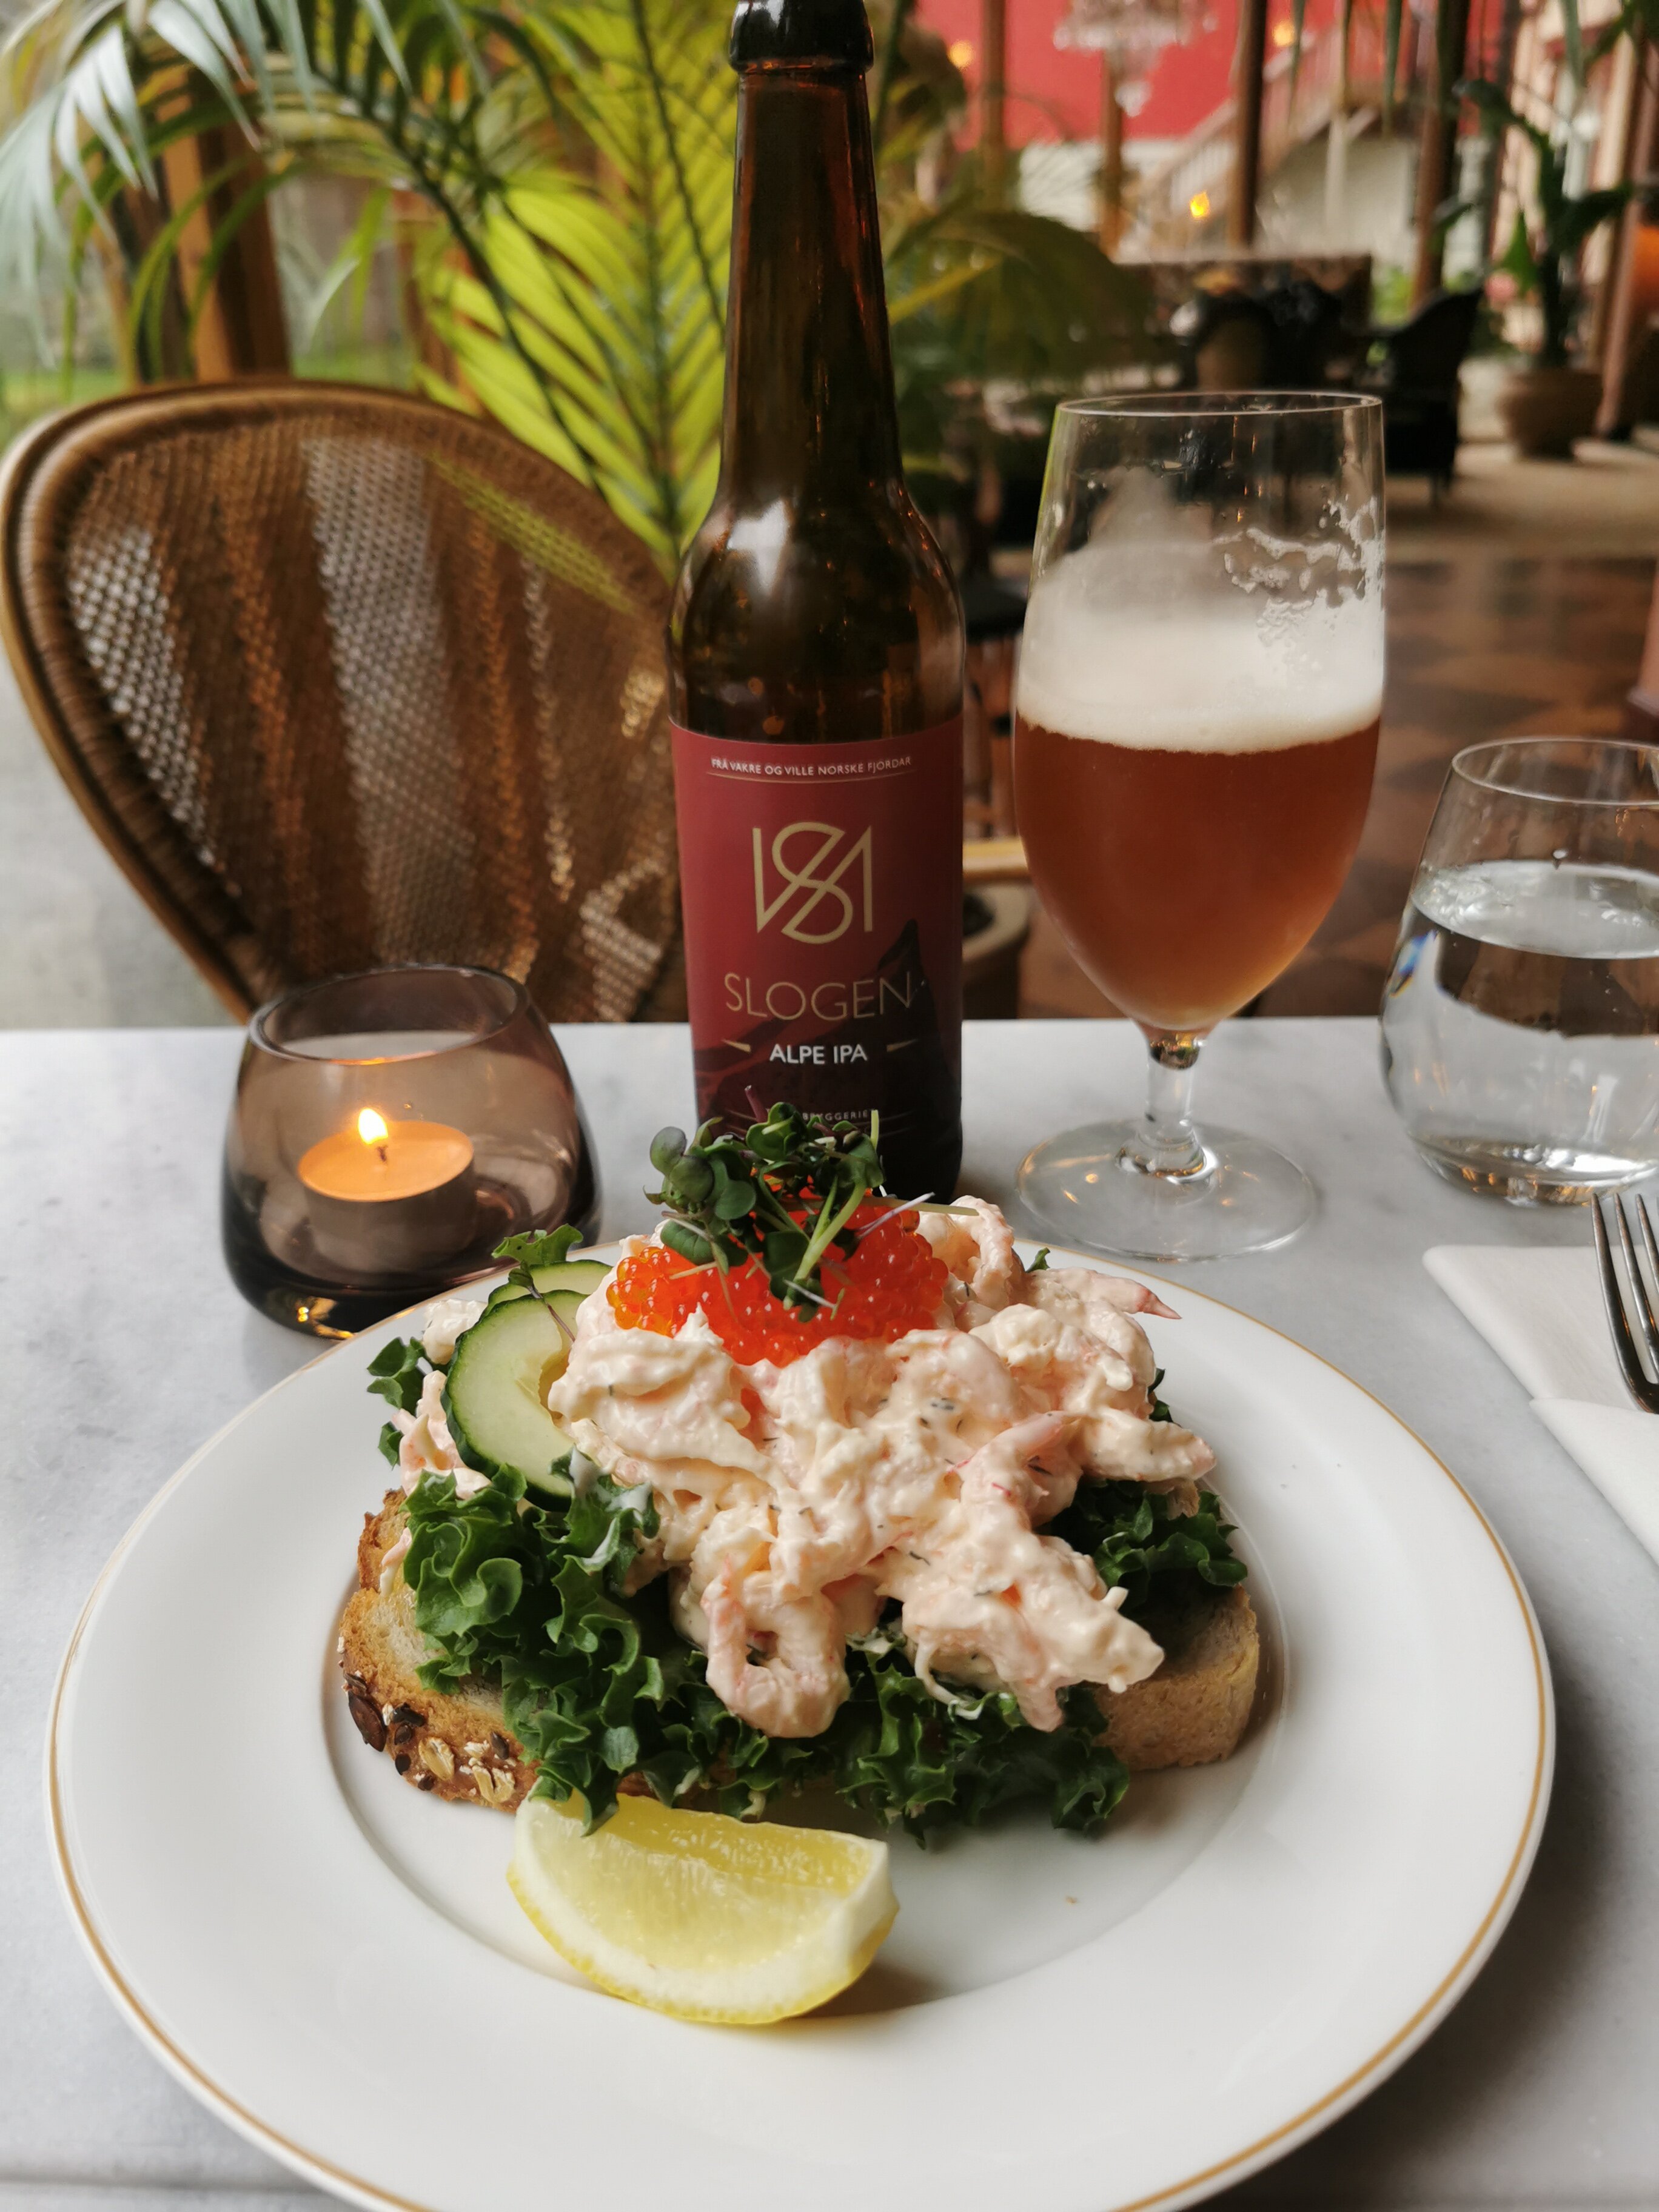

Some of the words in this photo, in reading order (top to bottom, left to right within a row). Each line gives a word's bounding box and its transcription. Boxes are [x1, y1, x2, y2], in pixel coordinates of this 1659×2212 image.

[729, 762, 762, 774] VAKRE
[764, 765, 782, 776] OG
[784, 765, 814, 776] VILLE
[817, 763, 864, 776] NORSKE
[867, 756, 911, 774] FJORDAR
[723, 971, 911, 1022] SLOGEN
[769, 1043, 825, 1065] ALPE
[833, 1043, 868, 1064] IPA
